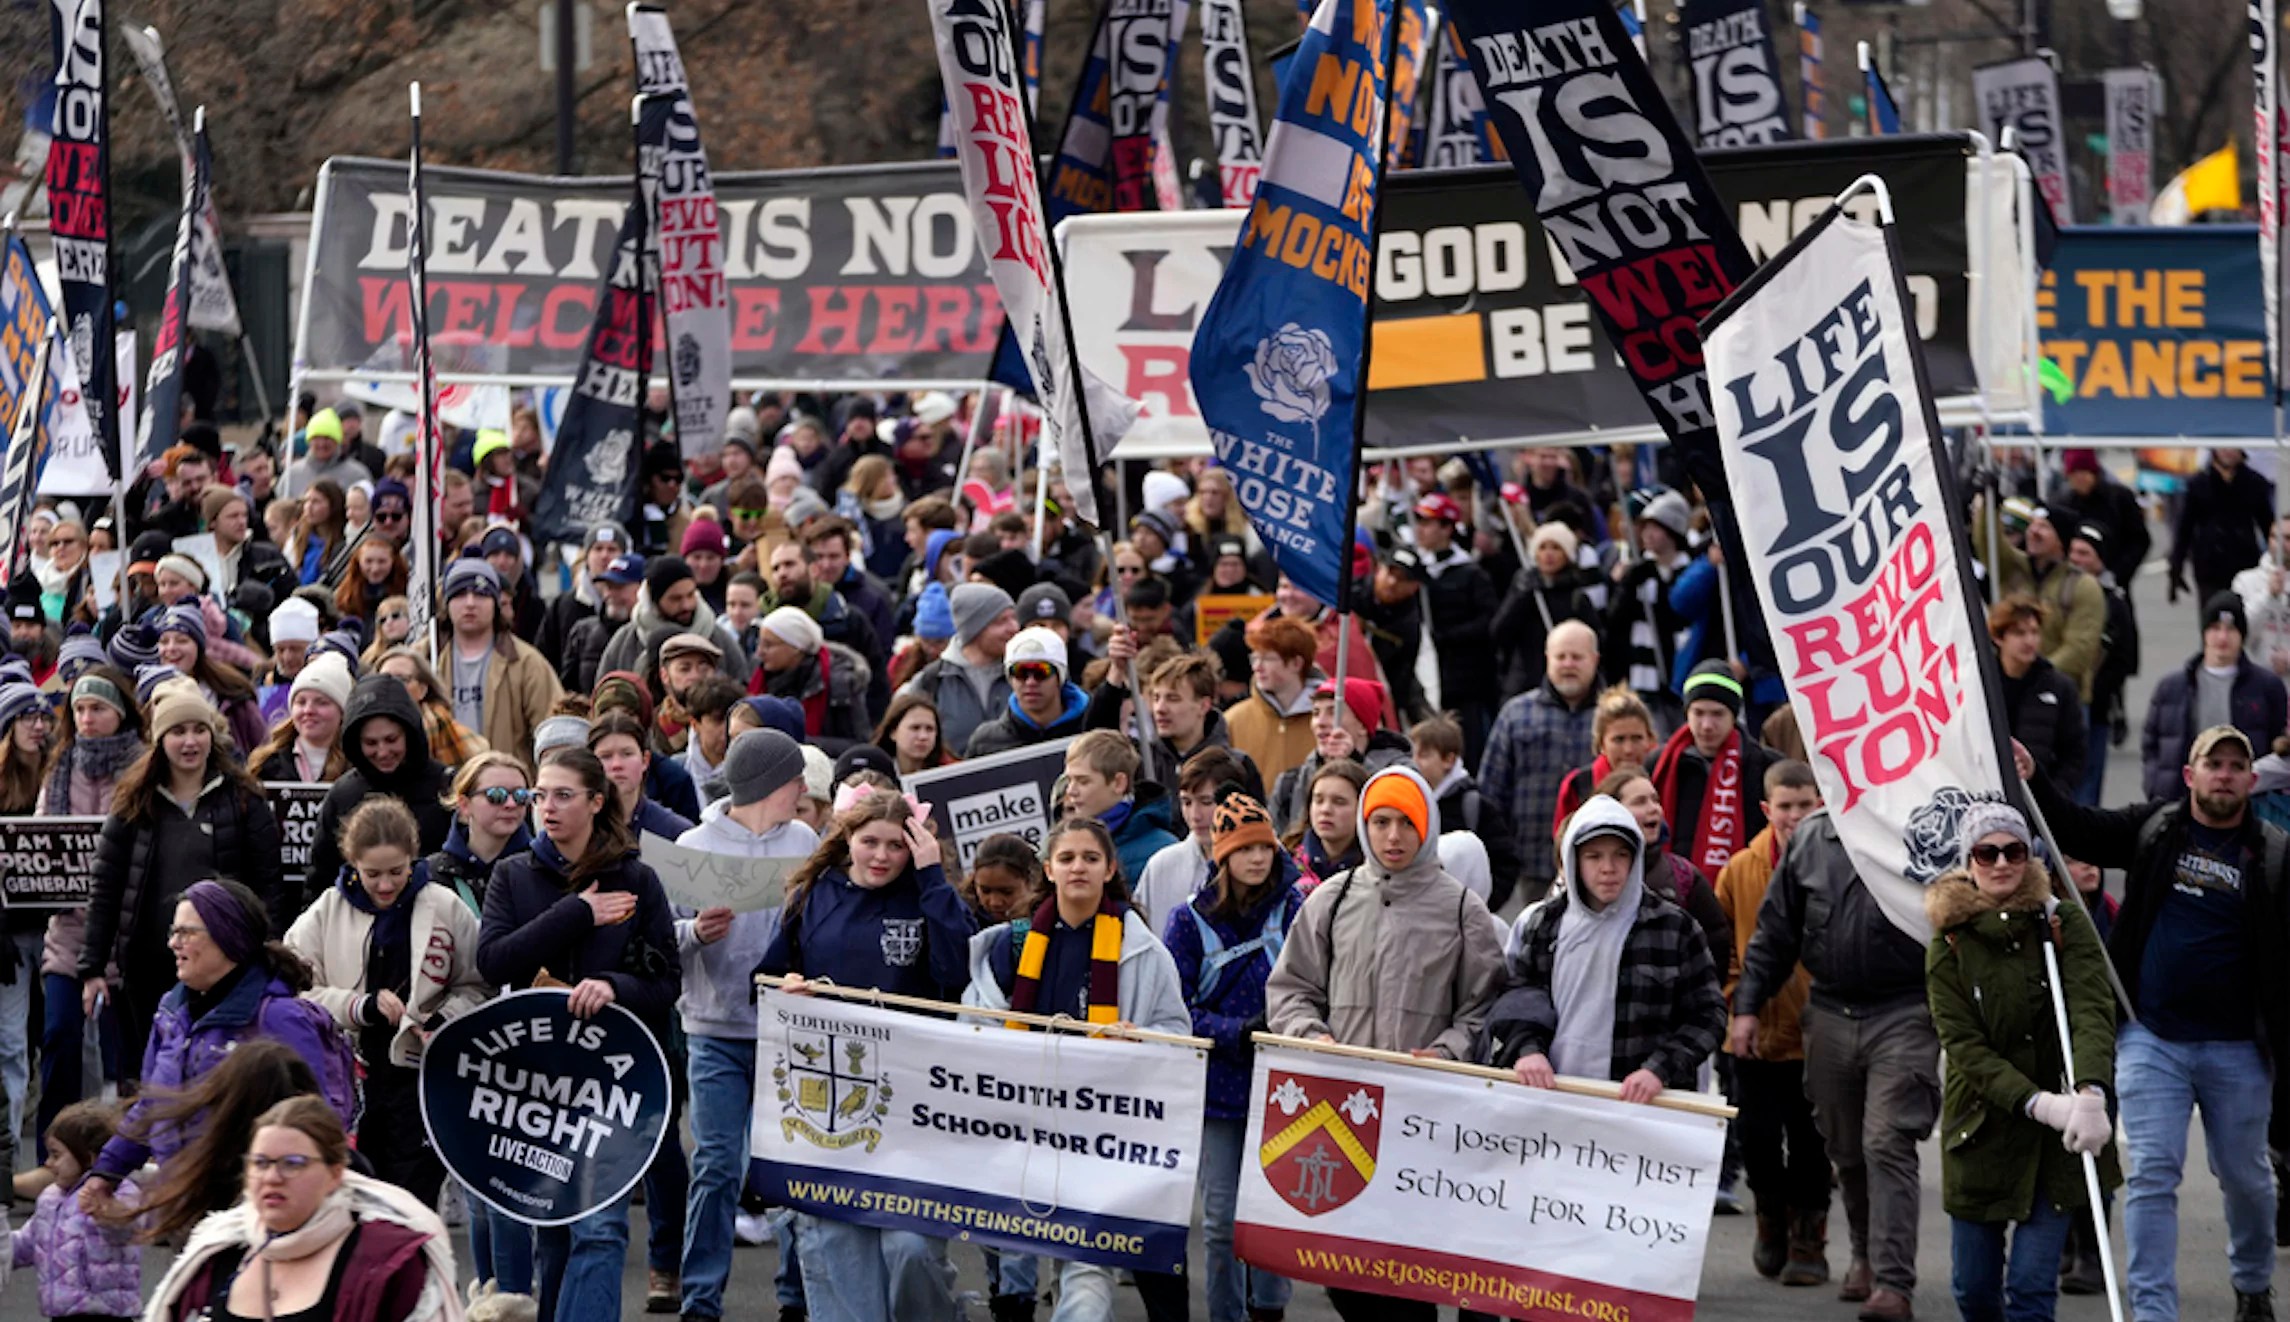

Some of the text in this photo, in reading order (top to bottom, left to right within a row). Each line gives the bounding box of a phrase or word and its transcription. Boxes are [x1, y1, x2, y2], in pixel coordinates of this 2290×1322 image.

[1471, 16, 1619, 88] DEATH
[1692, 43, 1780, 135] IS
[1304, 53, 1378, 148] NO
[1494, 71, 1674, 214] IS
[357, 193, 634, 278] DEAT
[716, 199, 812, 280] IS
[840, 192, 994, 278] NO
[660, 195, 719, 232] EVO
[661, 233, 721, 270] UT
[1242, 198, 1372, 305] MOCKE
[1541, 181, 1712, 272] NOT
[660, 272, 728, 314] ON!
[1375, 221, 1526, 301] GOD
[1578, 244, 1741, 331] WEL
[2074, 269, 2207, 328] THE
[357, 276, 781, 351] WELCE
[1489, 302, 1596, 379] BE
[1725, 276, 1881, 439] LIFE
[2040, 340, 2266, 398] TANCE
[1210, 427, 1338, 504] WHITE
[1266, 431, 1295, 450] THE
[1742, 342, 1903, 557] IS
[1769, 462, 1923, 615] OUR
[1782, 522, 1936, 679] REVO
[1796, 578, 1944, 744] LUT
[1819, 642, 1965, 815] ION!
[17, 834, 53, 850] AM
[955, 793, 1036, 829] make
[1704, 748, 1739, 866] BISHO
[5, 875, 90, 893] GENERAT
[471, 1017, 635, 1080] LIFE IS A
[457, 1052, 642, 1129] HUMAN
[468, 1085, 613, 1158] RIGHT
[976, 1073, 1067, 1108] EDITH
[1075, 1087, 1165, 1120] STEIN
[488, 1133, 574, 1182] LIVE ACTION
[912, 1103, 1181, 1170] SCHOOL FOR GIRLS
[786, 1178, 1145, 1255] WWW.STEDITHSTEINSCHOOL.ORG
